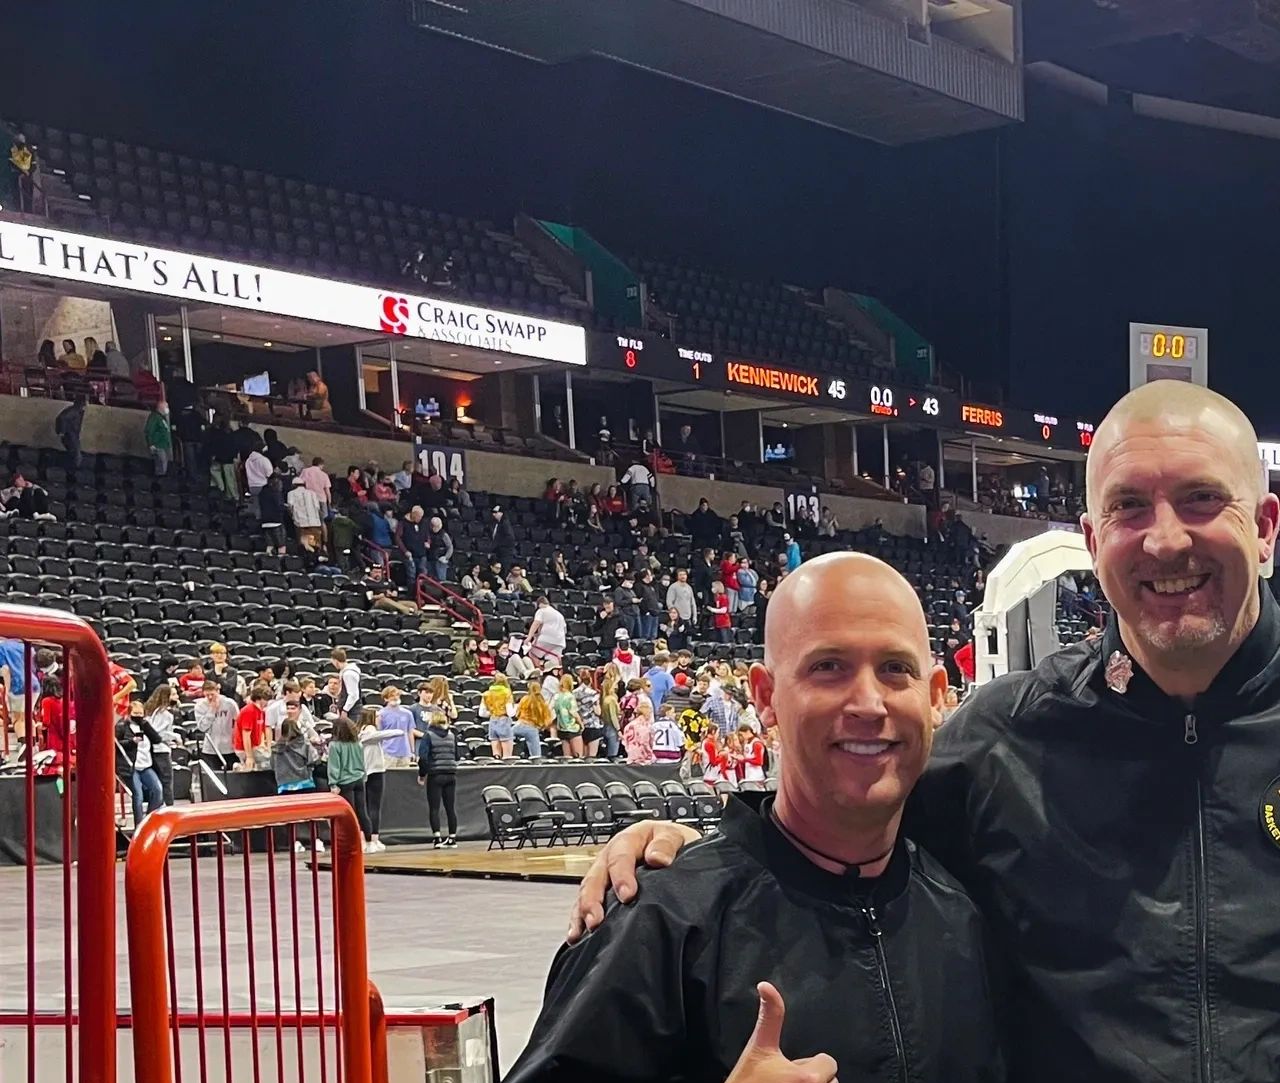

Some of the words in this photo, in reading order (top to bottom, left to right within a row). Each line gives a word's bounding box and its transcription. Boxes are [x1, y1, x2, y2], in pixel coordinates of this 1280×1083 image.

[27, 233, 169, 286] THAT'S
[182, 262, 262, 302] ALL!
[417, 302, 479, 331] CRAIG
[485, 314, 547, 342] SWAPP
[626, 350, 636, 367] 8
[692, 363, 700, 380] 1
[727, 362, 819, 396] KENNEWICK
[828, 381, 847, 399] 45
[870, 385, 893, 407] 0.0
[922, 397, 939, 416] 43
[962, 406, 1003, 427] FERRIS
[1042, 425, 1050, 439] 0
[655, 729, 670, 746] 21
